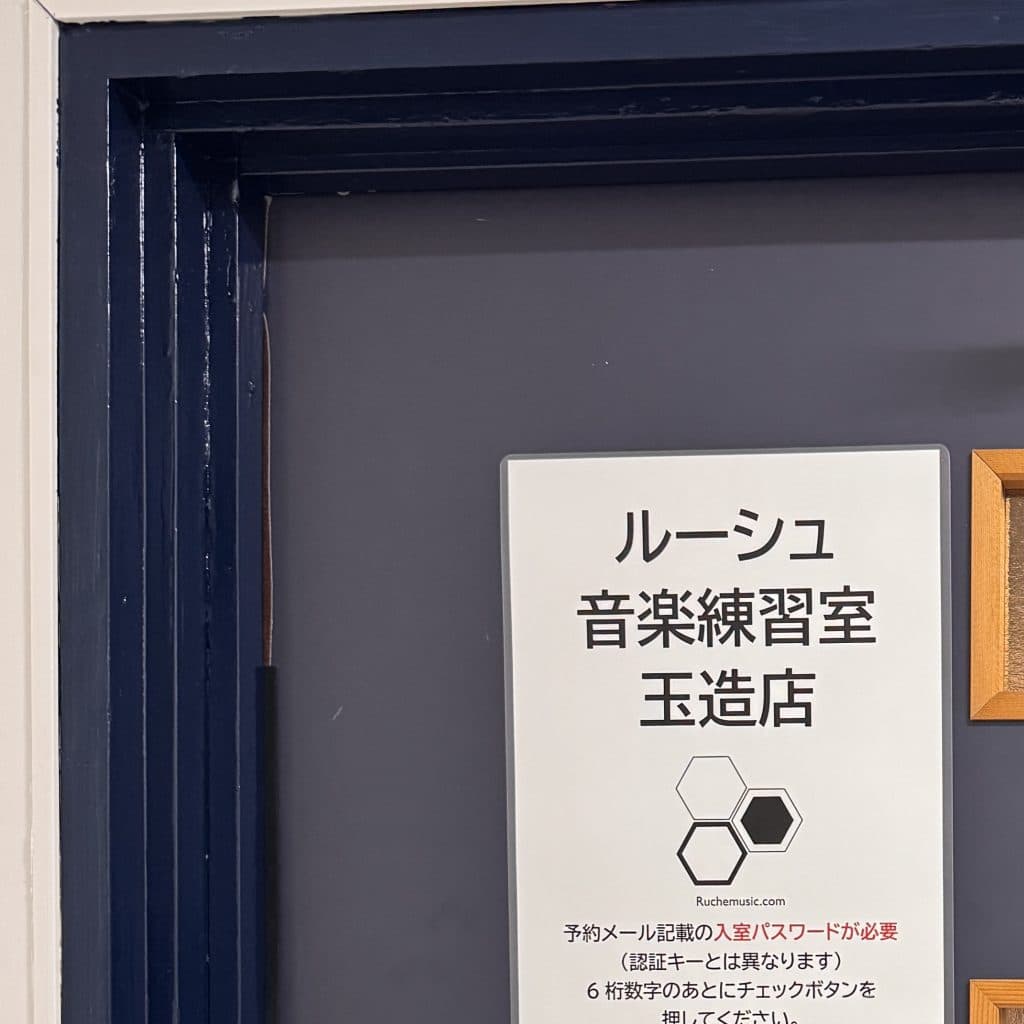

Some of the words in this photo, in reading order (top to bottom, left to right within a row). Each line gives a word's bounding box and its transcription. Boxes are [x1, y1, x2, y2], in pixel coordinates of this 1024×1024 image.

[615, 508, 834, 563] ルーシュ
[576, 585, 877, 648] 音楽練習室
[639, 668, 816, 728] 玉造店
[696, 895, 786, 908] Ruchemusic.com
[563, 921, 899, 944] 予約メール記載の入室パスワードが必要
